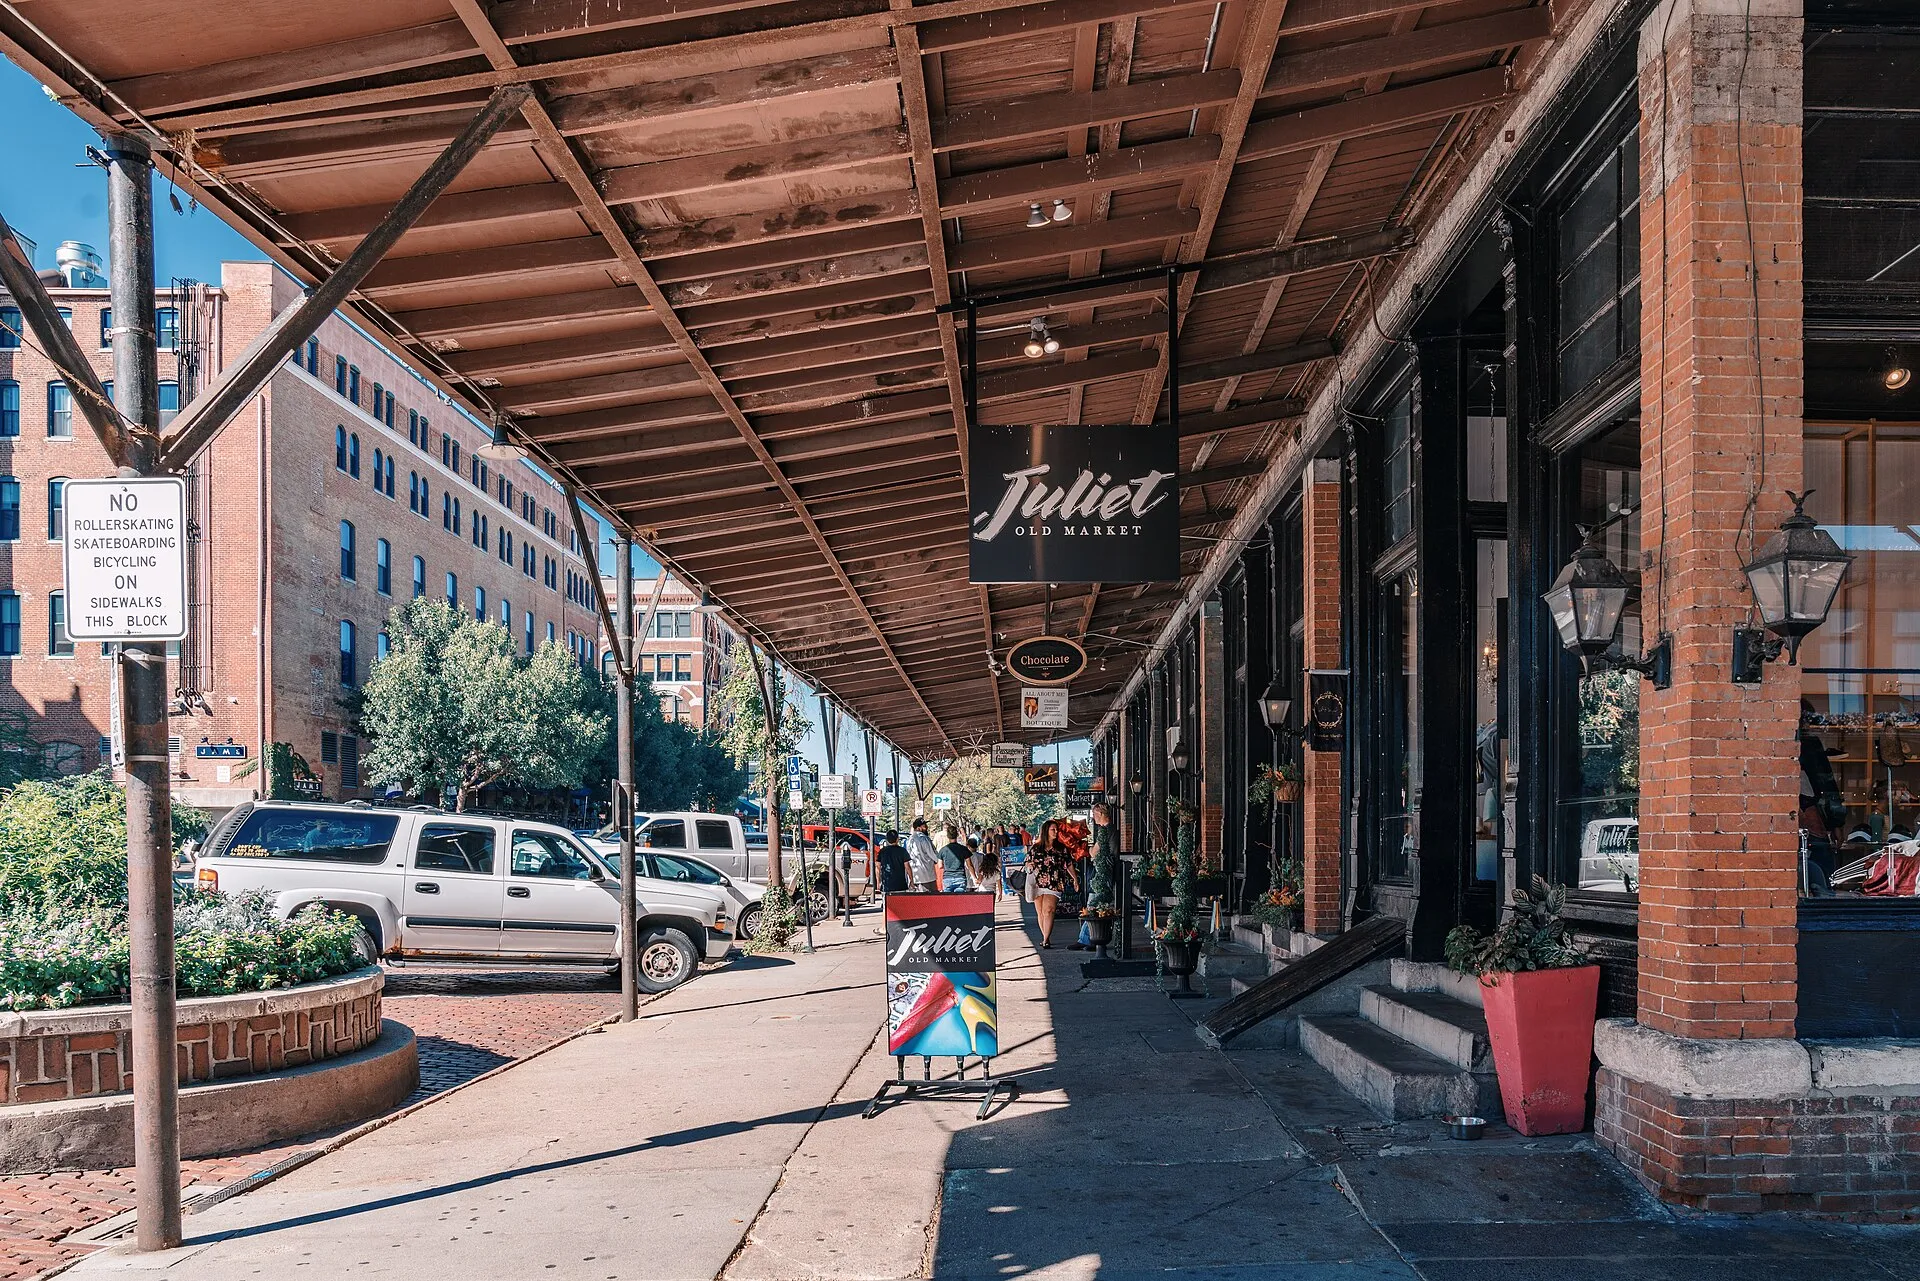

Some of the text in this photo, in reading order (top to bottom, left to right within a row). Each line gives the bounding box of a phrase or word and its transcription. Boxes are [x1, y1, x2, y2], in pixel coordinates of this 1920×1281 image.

[110, 493, 138, 512] NO
[973, 463, 1176, 542] Juliet
[74, 518, 174, 531] ROLLERSKATING
[1015, 525, 1143, 536] OLD MARKET
[73, 537, 176, 549] SKATEBOARDING
[94, 556, 157, 568] BICYCLING
[114, 574, 138, 590] ON
[90, 596, 162, 608] SIDEWALKS
[85, 615, 168, 627] THIS BLOCK
[1020, 654, 1070, 666] Chocolate
[200, 746, 241, 755] JAMS
[995, 745, 1028, 757] Passageway
[995, 754, 1017, 765] Gallery
[296, 781, 319, 790] JAMS
[1028, 780, 1057, 788] PRIME
[934, 796, 943, 807] P
[1067, 794, 1091, 802] Market
[887, 923, 993, 966] Juliet
